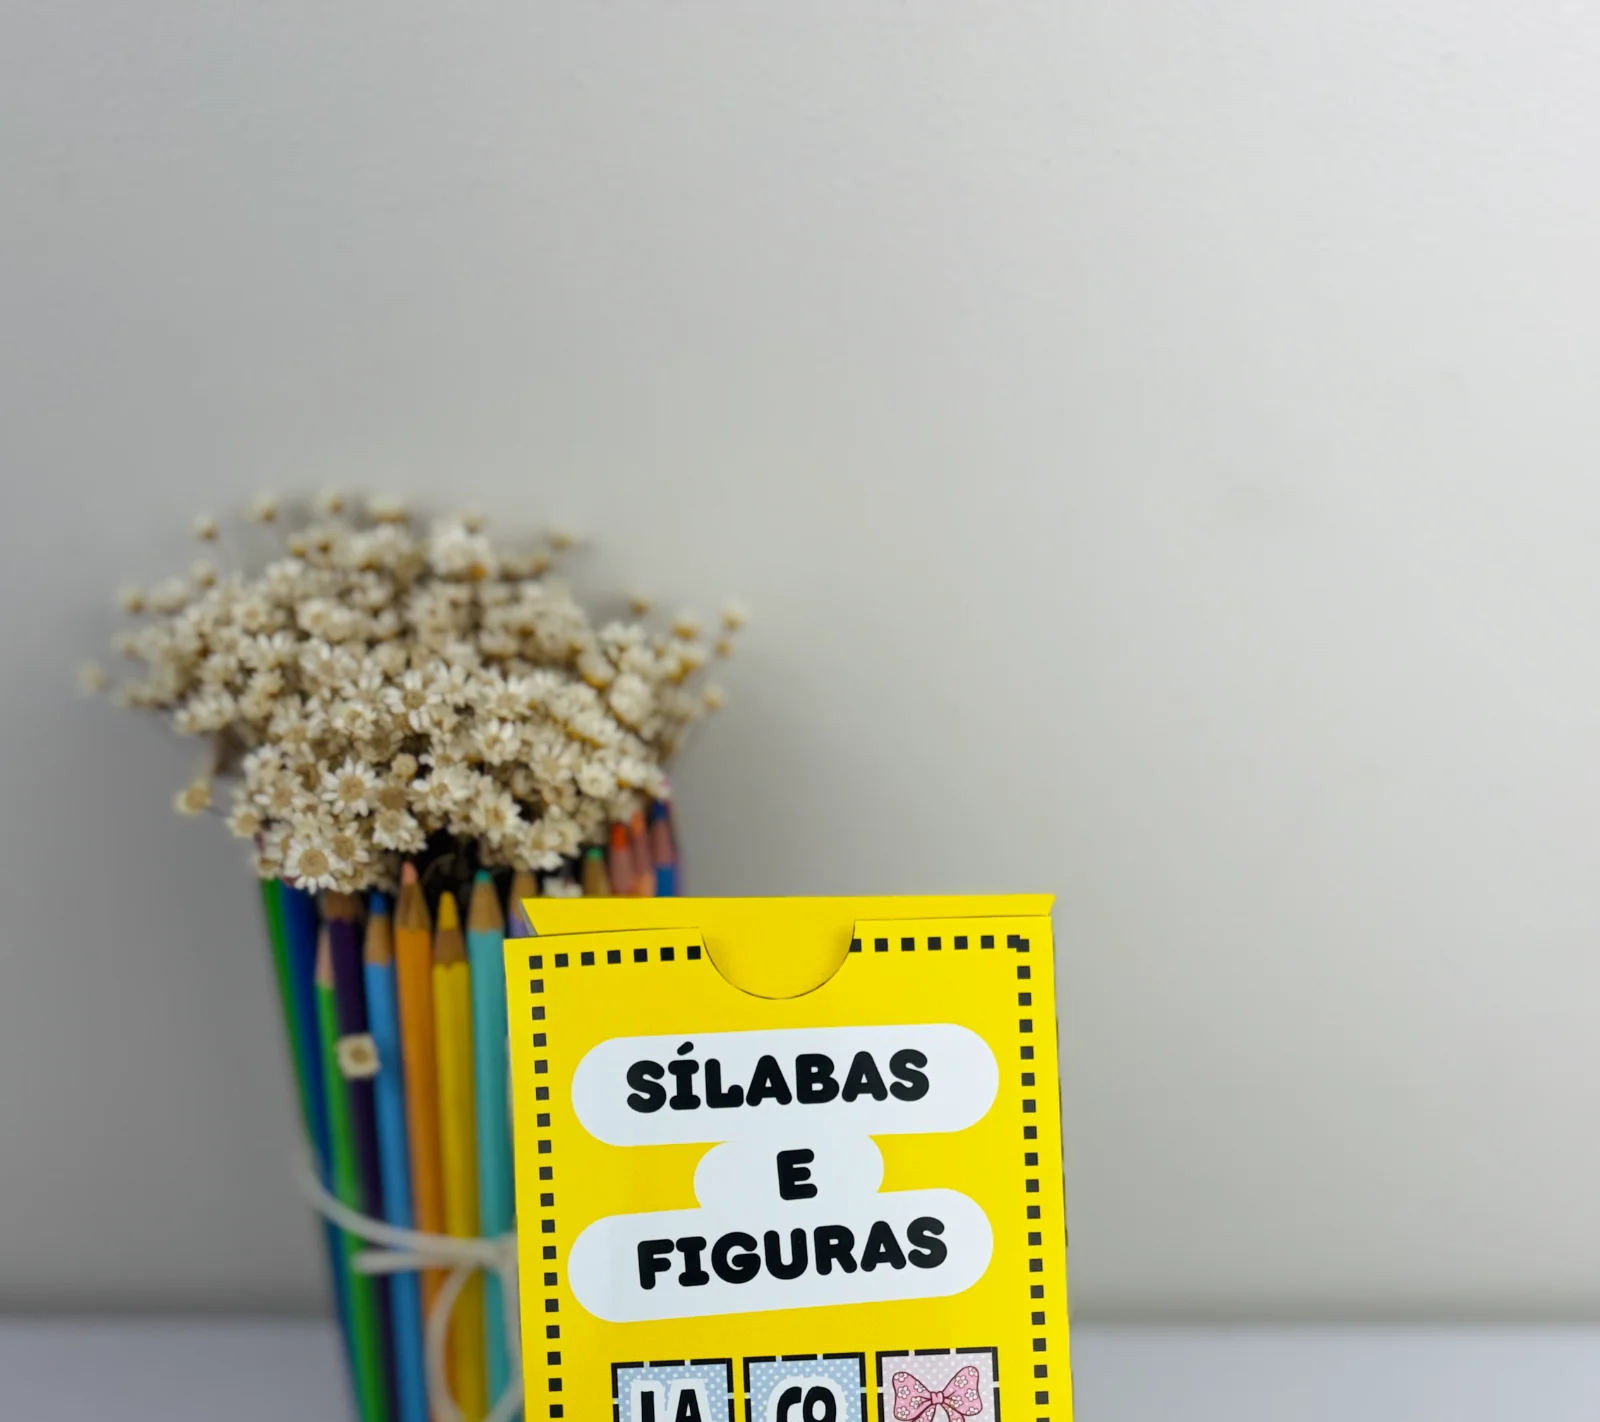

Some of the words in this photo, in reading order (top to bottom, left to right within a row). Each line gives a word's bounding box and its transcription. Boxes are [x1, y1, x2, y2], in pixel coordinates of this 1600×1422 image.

[626, 1041, 930, 1114] SÍLABAS
[776, 1148, 818, 1201] E
[637, 1216, 948, 1290] FIGURAS
